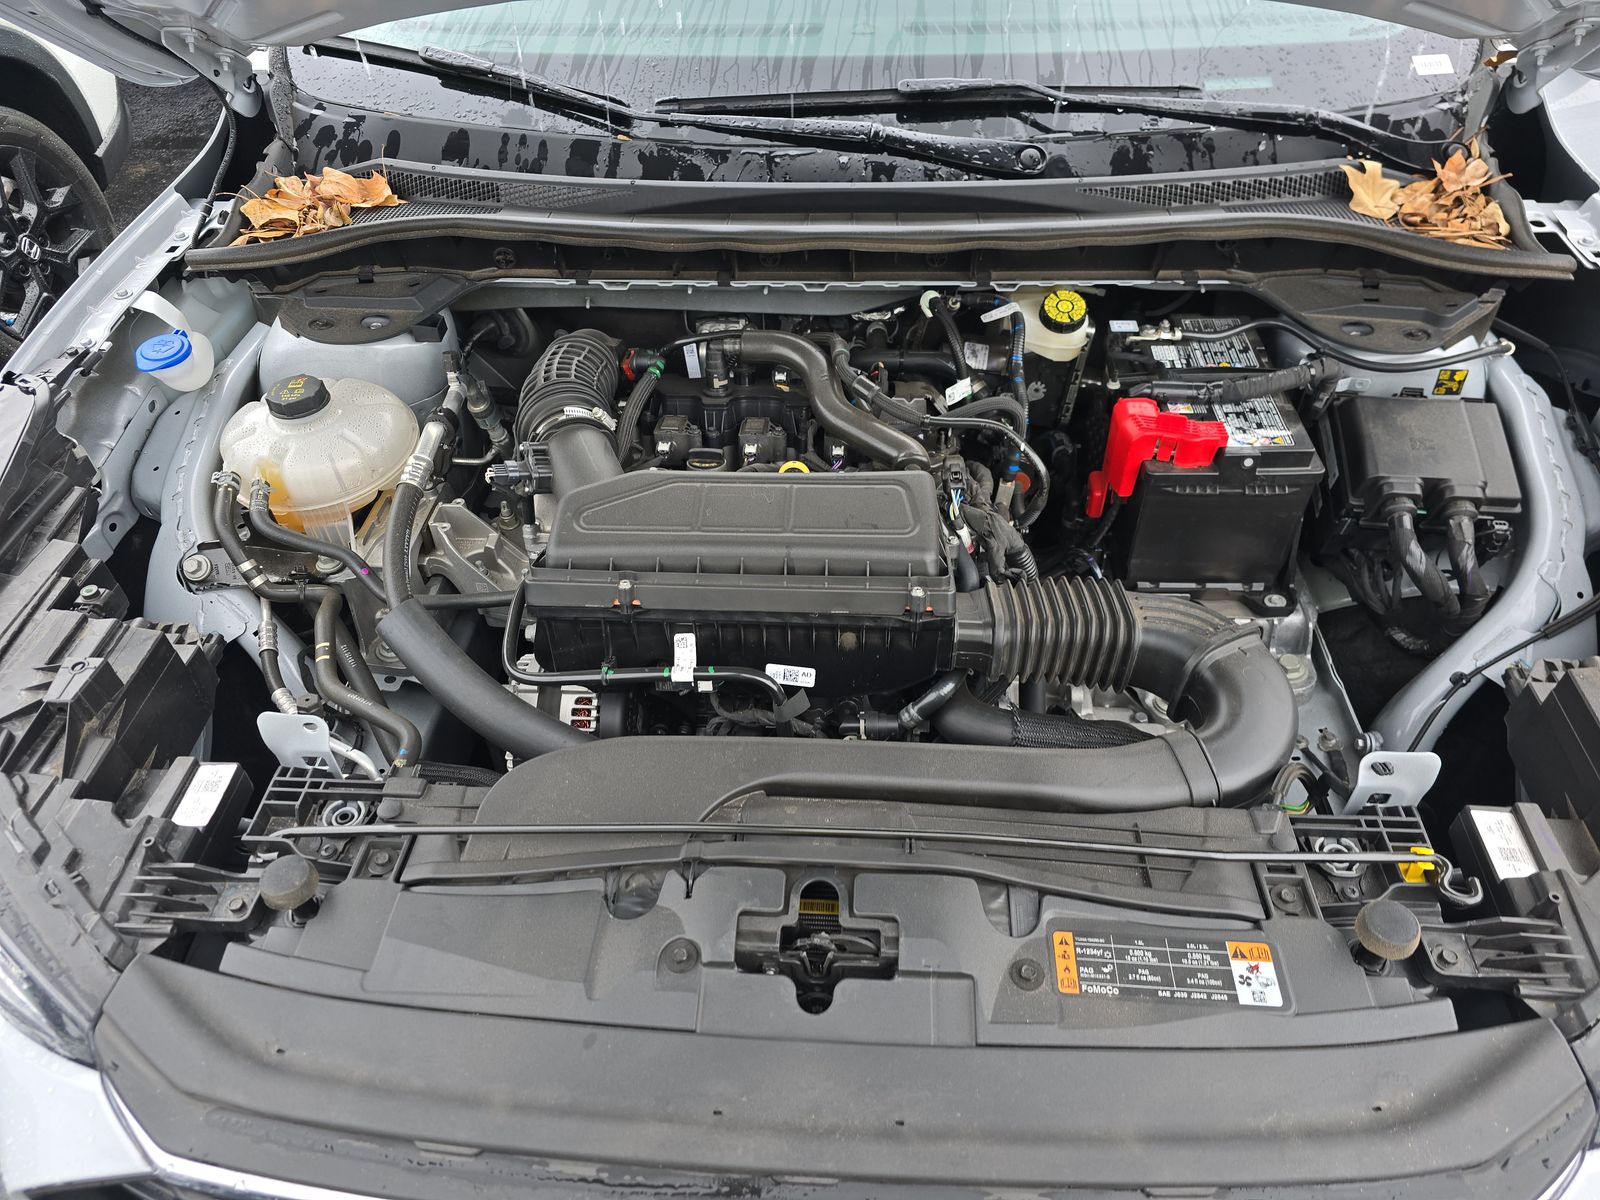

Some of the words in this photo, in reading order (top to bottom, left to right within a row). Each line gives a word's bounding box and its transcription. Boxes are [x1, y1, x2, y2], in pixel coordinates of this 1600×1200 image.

[1076, 947, 1103, 956] R-1234yf
[1144, 950, 1152, 958] kg
[1203, 953, 1211, 961] kg
[1082, 984, 1119, 995] FoMoCo
